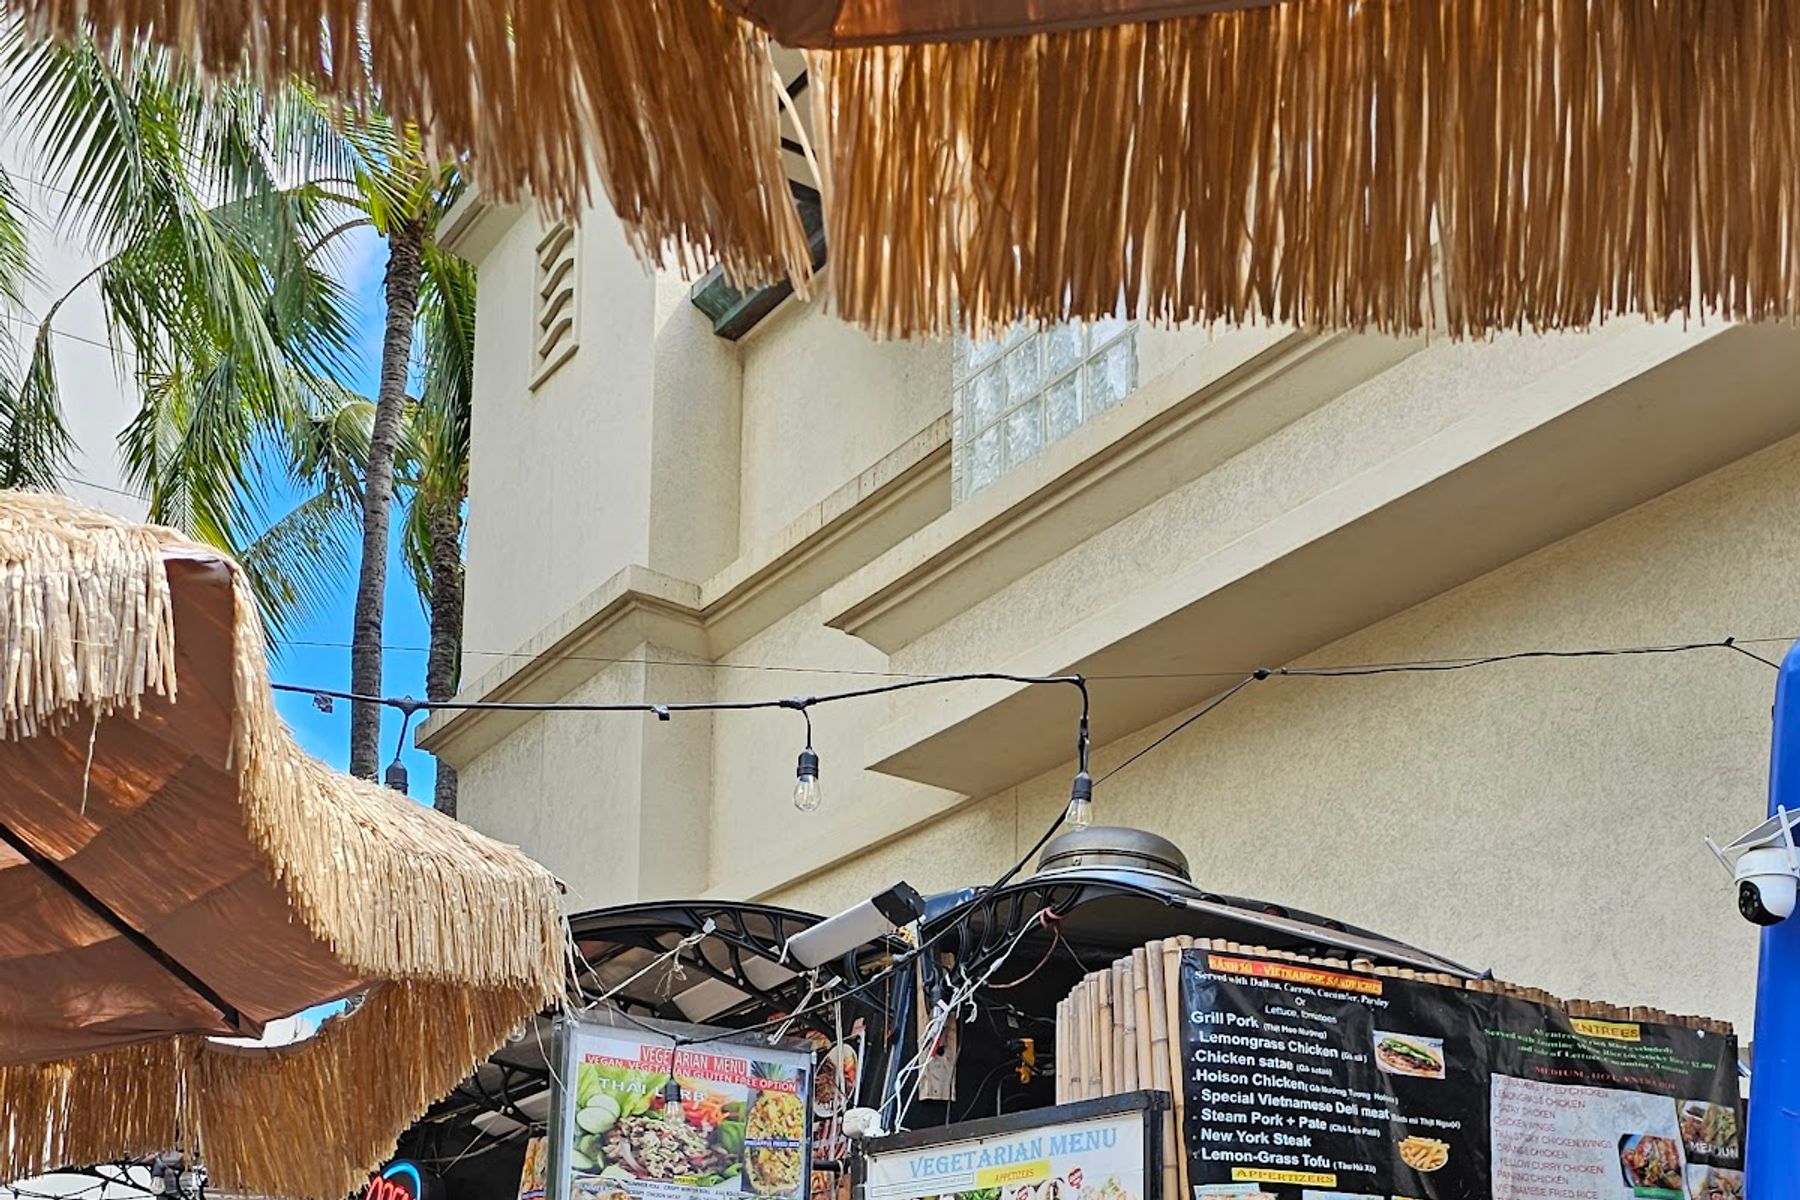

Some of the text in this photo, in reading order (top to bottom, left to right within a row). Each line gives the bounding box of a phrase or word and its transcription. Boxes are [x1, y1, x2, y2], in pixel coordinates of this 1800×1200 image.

[1262, 963, 1327, 985] VIETNAMESE
[1195, 970, 1227, 982] Served
[1228, 974, 1248, 986] with
[1284, 983, 1316, 997] Carrots,
[1361, 995, 1390, 1010] Parsley
[1226, 1013, 1260, 1029] Pork
[1301, 1010, 1338, 1025] tomatoes
[1199, 1030, 1339, 1059] Lemongrass Chicken
[587, 1055, 626, 1069] VEGAN,
[694, 1070, 733, 1084] GLUTEN
[734, 1075, 758, 1087] FREE
[759, 1079, 797, 1092] OPTION
[715, 1058, 747, 1076] MENU
[599, 1079, 705, 1101] THAI LRB
[1201, 1087, 1390, 1121] Special Vietnamese Deli meat
[1545, 1097, 1586, 1109] CHICKEN
[1201, 1108, 1248, 1124] Steam
[1251, 1112, 1284, 1127] Pork
[1286, 1117, 1296, 1127] +
[1201, 1128, 1312, 1148] New York Steak
[1541, 1135, 1580, 1148] CHICKEN
[909, 1127, 1118, 1180] VEGETARIAN MENU
[1202, 1147, 1331, 1169] Lemon-Grass Tofu
[1530, 1147, 1569, 1159] CHICKEN
[1531, 1160, 1561, 1171] CURRY
[1562, 1163, 1605, 1175] CHICKEN
[1530, 1173, 1569, 1185] CHICKEN
[1548, 1187, 1599, 1200] FRIED RICE
